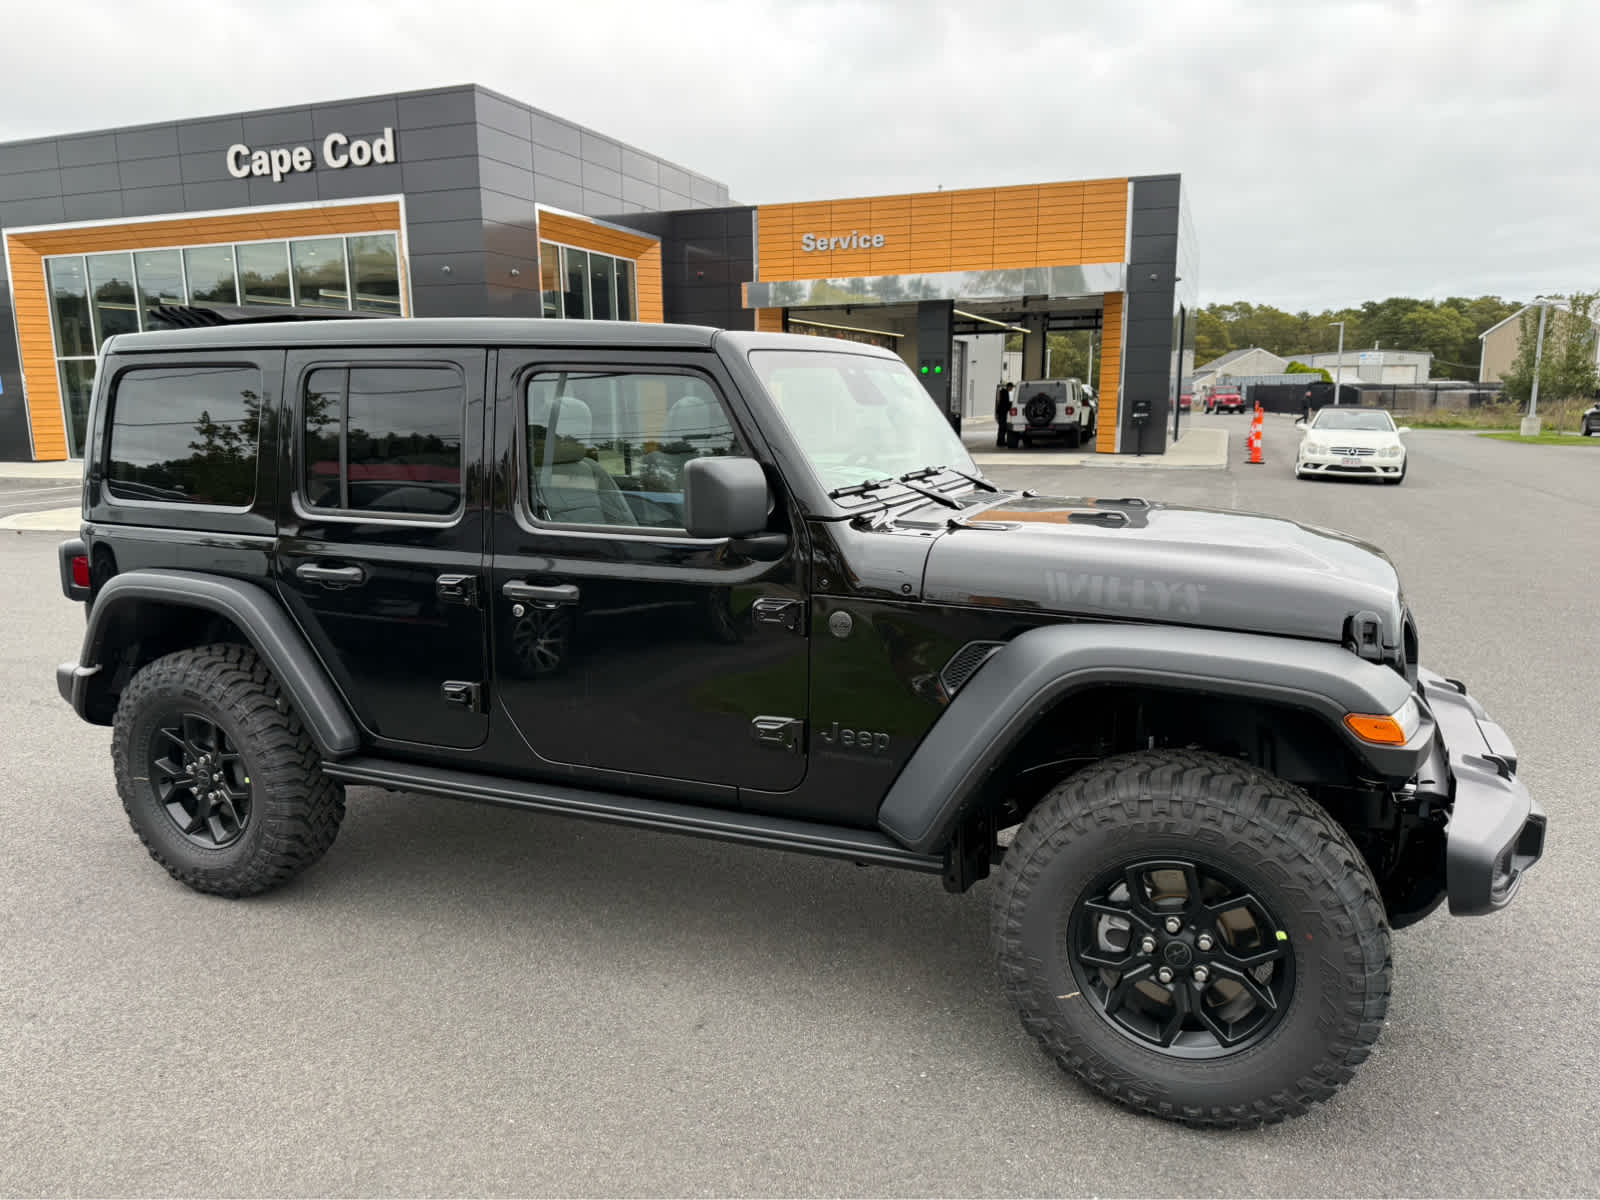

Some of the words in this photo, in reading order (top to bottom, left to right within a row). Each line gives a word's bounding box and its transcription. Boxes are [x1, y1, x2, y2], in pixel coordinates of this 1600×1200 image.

[226, 143, 313, 183] Cape
[322, 127, 396, 169] Cod
[801, 230, 886, 252] Service
[1043, 569, 1207, 615] WILLYS
[820, 721, 891, 758] Jeep
